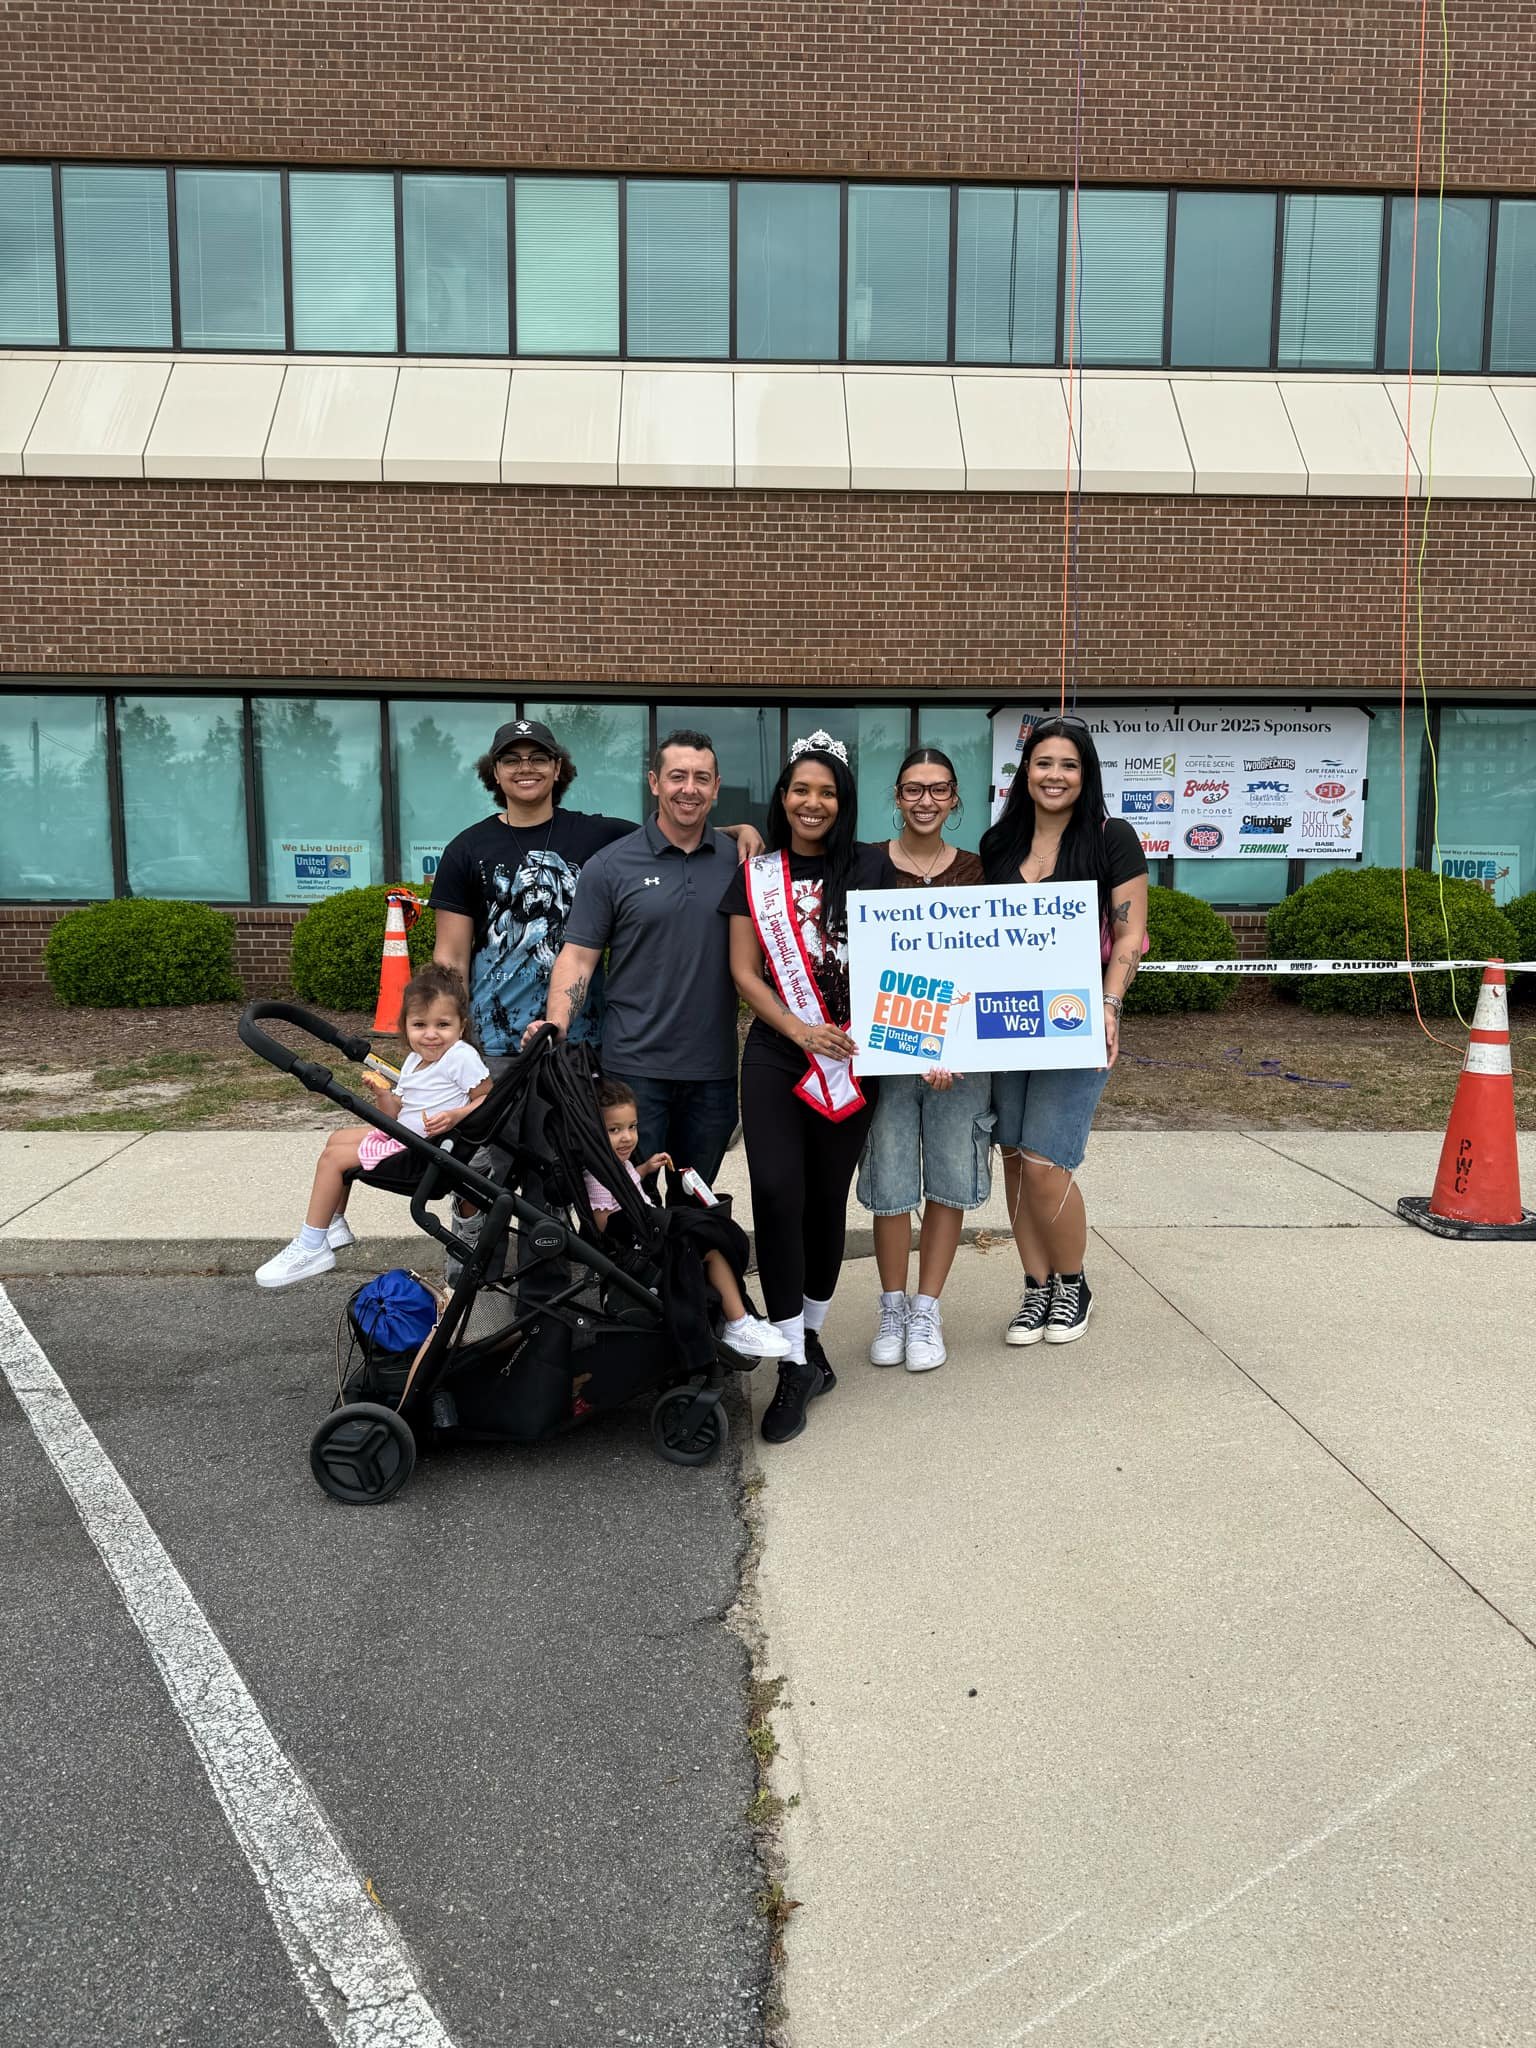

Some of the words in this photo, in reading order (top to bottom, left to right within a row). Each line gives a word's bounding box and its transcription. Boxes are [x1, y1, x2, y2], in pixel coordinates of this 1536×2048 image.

[1112, 719, 1144, 733] You
[1145, 719, 1160, 733] to
[1162, 718, 1184, 733] All
[1187, 718, 1218, 733] Our
[1220, 718, 1260, 733] 2025
[1263, 718, 1332, 736] Sponsors
[1124, 757, 1162, 770] HOME
[1184, 760, 1212, 768] COFFEE
[1213, 760, 1235, 768] SCENE
[1243, 759, 1295, 771] WOODPECKERS
[1246, 780, 1289, 793] PWC
[1123, 793, 1152, 801] United
[1134, 801, 1152, 811] Way
[1181, 807, 1233, 815] metronet
[1242, 815, 1293, 828] Climbing
[1302, 811, 1329, 824] DUCK
[1301, 824, 1341, 838] DONUTS
[281, 843, 297, 852] We
[300, 843, 322, 852] Live
[325, 844, 364, 853] United!
[1140, 839, 1170, 852] awa
[1239, 844, 1289, 853] TERMINIX
[296, 856, 326, 866] United
[307, 866, 326, 876] Way
[1442, 859, 1485, 878] over
[858, 904, 867, 922] I
[873, 904, 924, 922] went
[929, 901, 981, 920] Over
[985, 897, 1028, 918] The
[1033, 895, 1087, 920] Edge
[890, 931, 922, 951] for
[927, 927, 1000, 950] United
[1005, 926, 1057, 951] Way!
[1331, 961, 1398, 970] CAUTION
[879, 969, 942, 1001] over
[936, 980, 955, 1004] the
[977, 995, 1041, 1014] United
[873, 991, 951, 1036] EDGE
[1003, 1014, 1041, 1036] Way
[868, 1023, 886, 1050] FOR
[887, 1029, 919, 1043] United
[898, 1040, 917, 1054] Way
[1454, 1138, 1473, 1195] PWC
